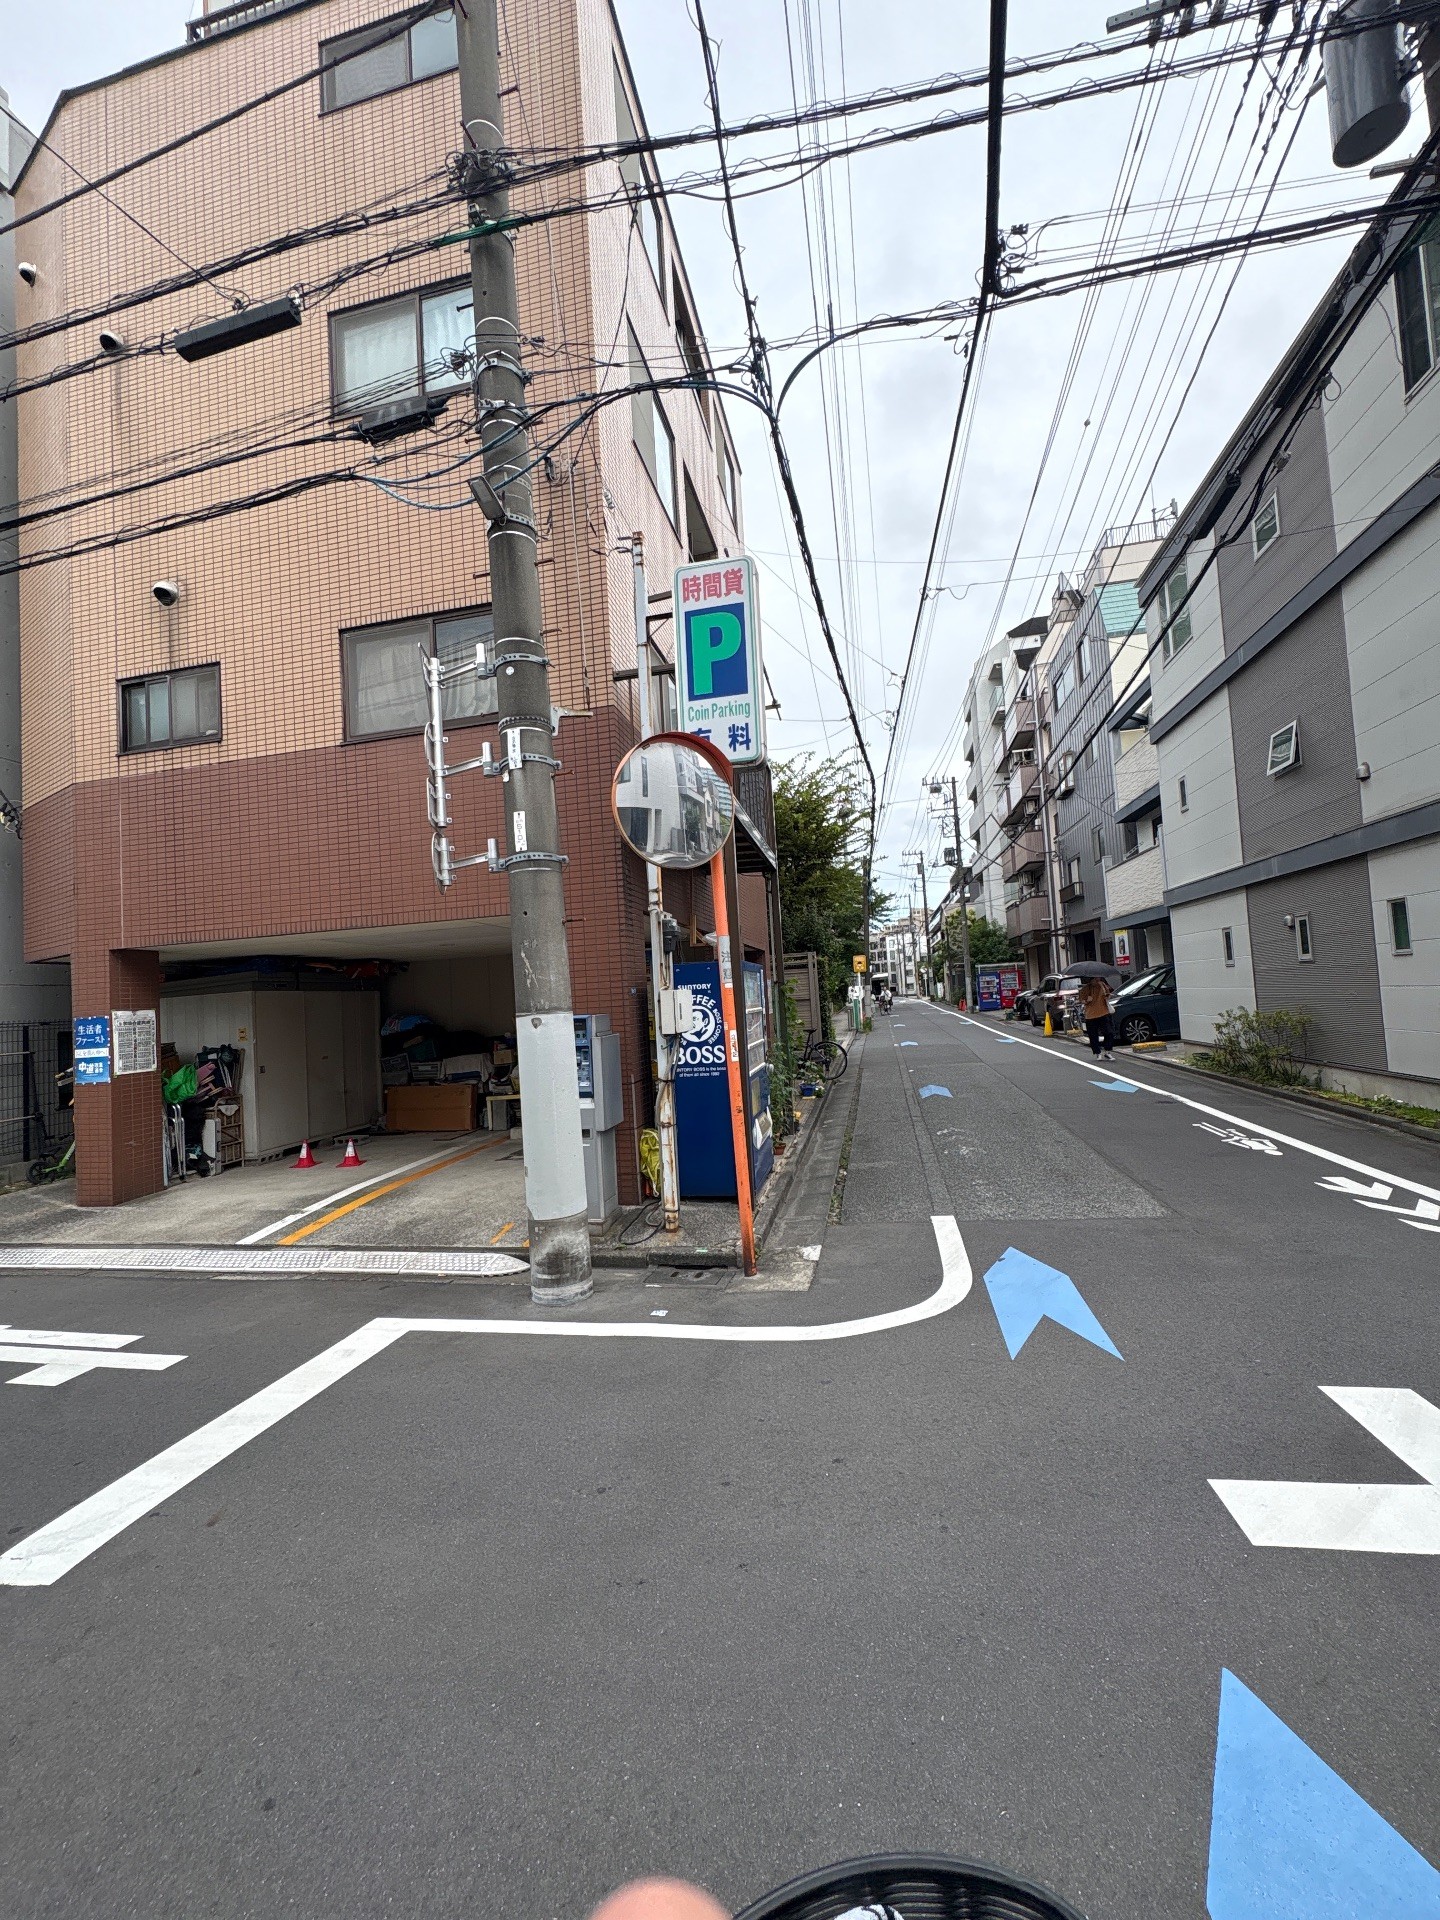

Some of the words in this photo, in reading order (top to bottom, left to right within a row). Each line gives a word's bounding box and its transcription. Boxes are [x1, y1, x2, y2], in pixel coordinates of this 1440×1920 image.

[682, 567, 744, 604] 時間貸
[690, 611, 742, 696] P
[687, 705, 710, 723] Coin
[712, 700, 751, 719] Parking
[78, 1024, 102, 1035] 生活者
[75, 1035, 105, 1046] ファースト
[672, 1045, 726, 1065] BOSS
